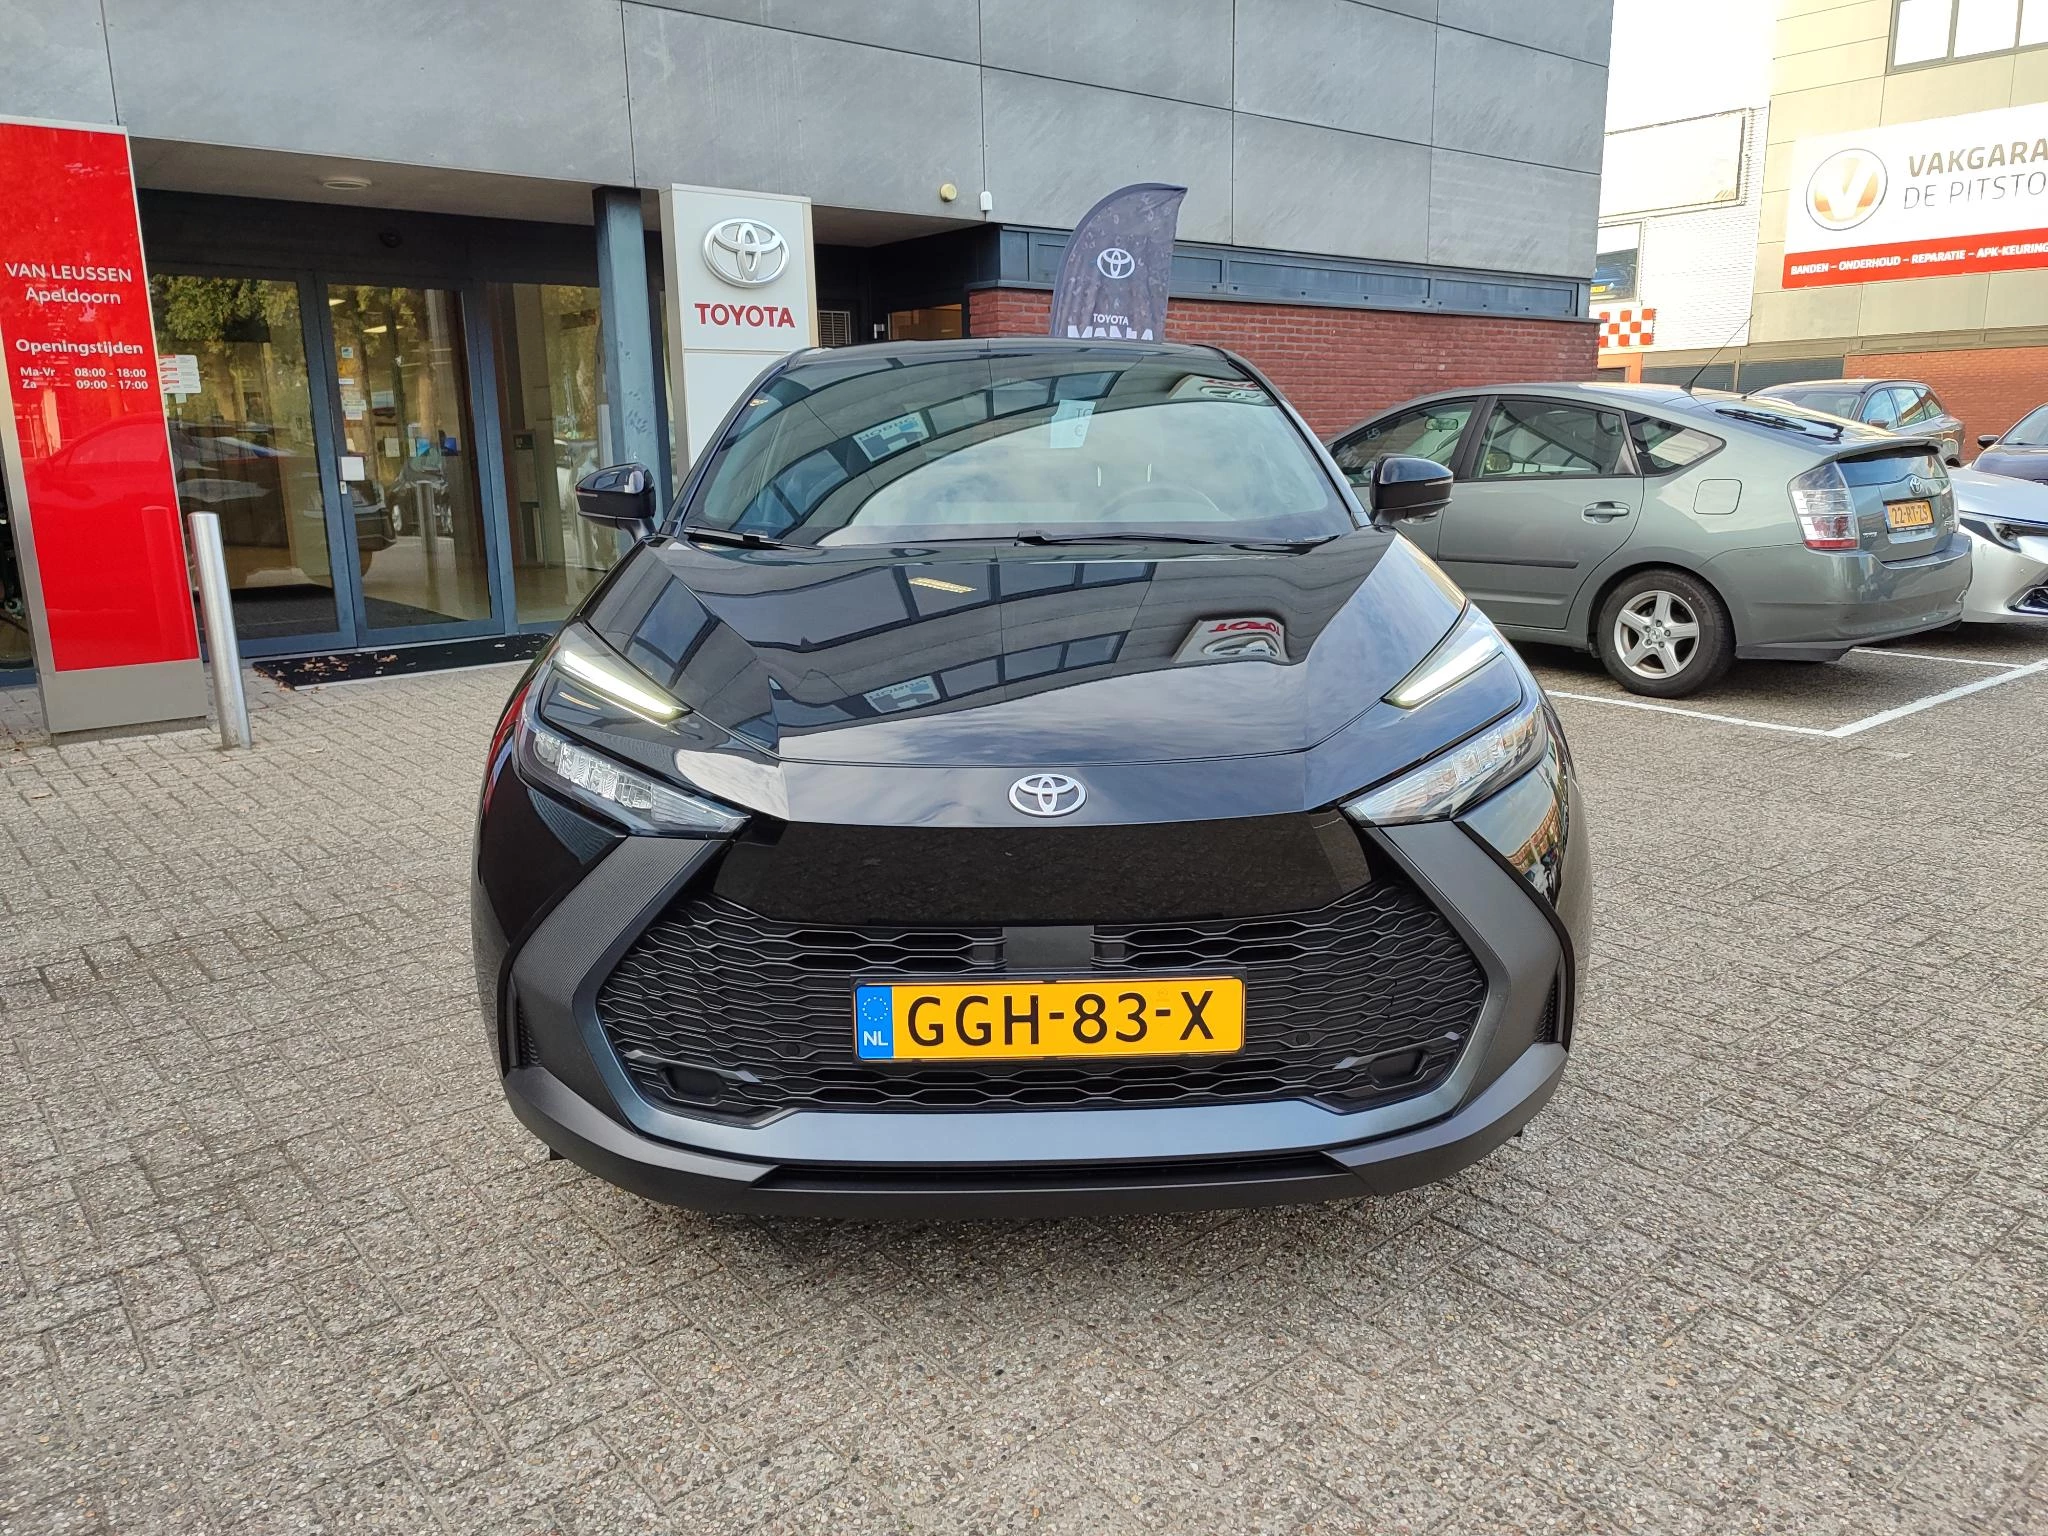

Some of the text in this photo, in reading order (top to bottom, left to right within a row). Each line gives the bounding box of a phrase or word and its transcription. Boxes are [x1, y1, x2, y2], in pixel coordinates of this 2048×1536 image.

[1908, 138, 2048, 177] VAKGARA
[1903, 171, 2047, 209] DE PITSTO
[5, 262, 132, 282] VAN LEUSSEN
[1790, 261, 1830, 276] BANDEN
[1838, 255, 1902, 272] ONDERHOUD
[1911, 249, 1967, 265] REPARATIE
[26, 286, 121, 304] Apeldoorn
[694, 303, 796, 328] TOYOTA
[1093, 312, 1129, 326] TOYOTA
[15, 339, 143, 357] Openingstijden
[20, 366, 55, 377] Ma-Vr
[74, 368, 106, 378] 08:00
[117, 368, 147, 378] 18:00
[22, 379, 37, 389] Za
[76, 380, 108, 390] 09:00
[119, 380, 149, 390] 17:00
[863, 990, 1214, 1047] NL GGH-83-X
